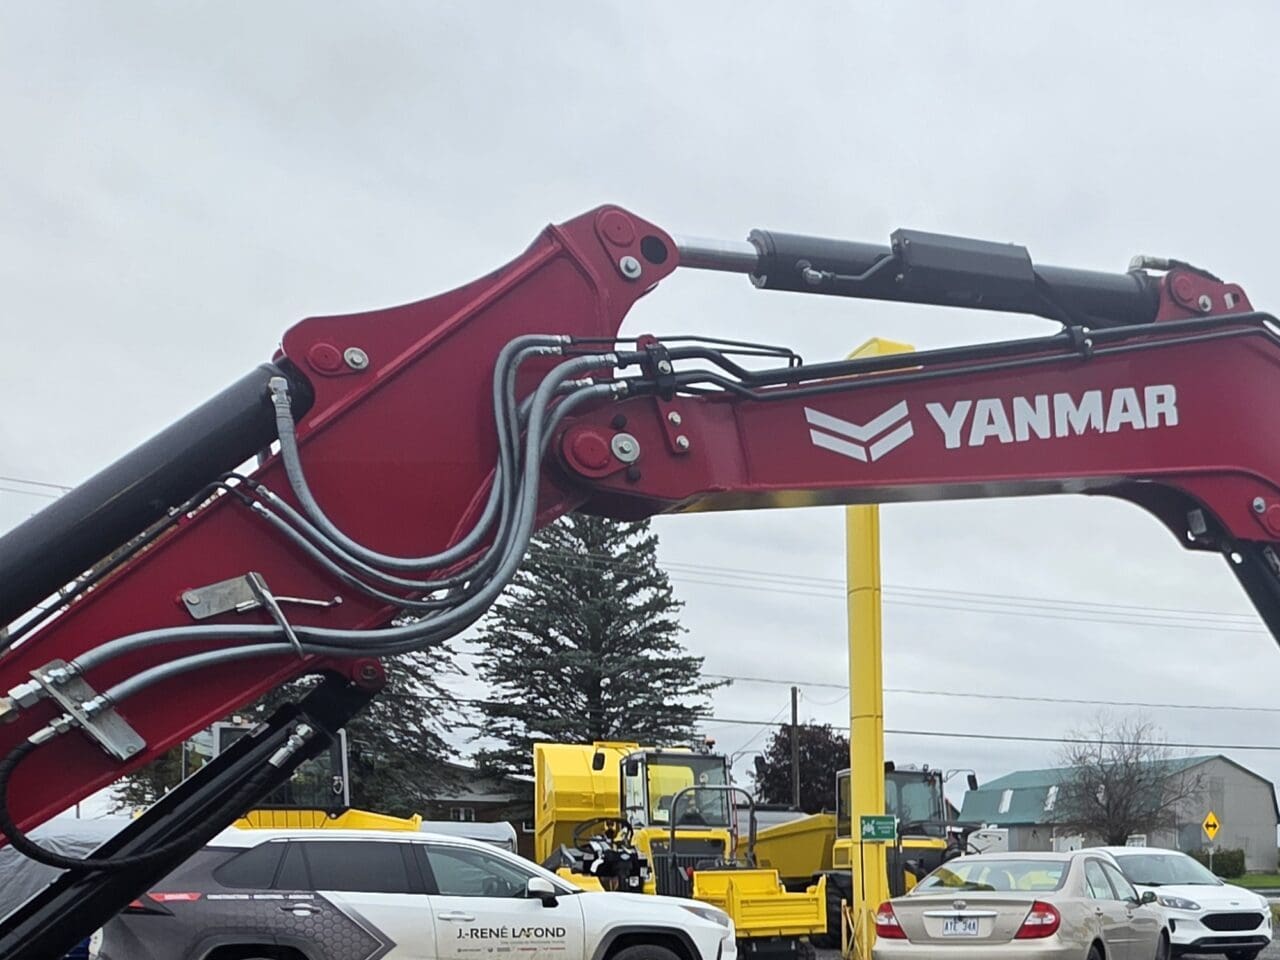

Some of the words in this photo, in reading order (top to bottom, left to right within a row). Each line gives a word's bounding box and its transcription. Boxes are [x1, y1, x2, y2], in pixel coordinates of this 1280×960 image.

[926, 384, 1179, 449] YANMAR
[457, 925, 508, 939] J.-RENÉ
[512, 927, 566, 938] LAFOND
